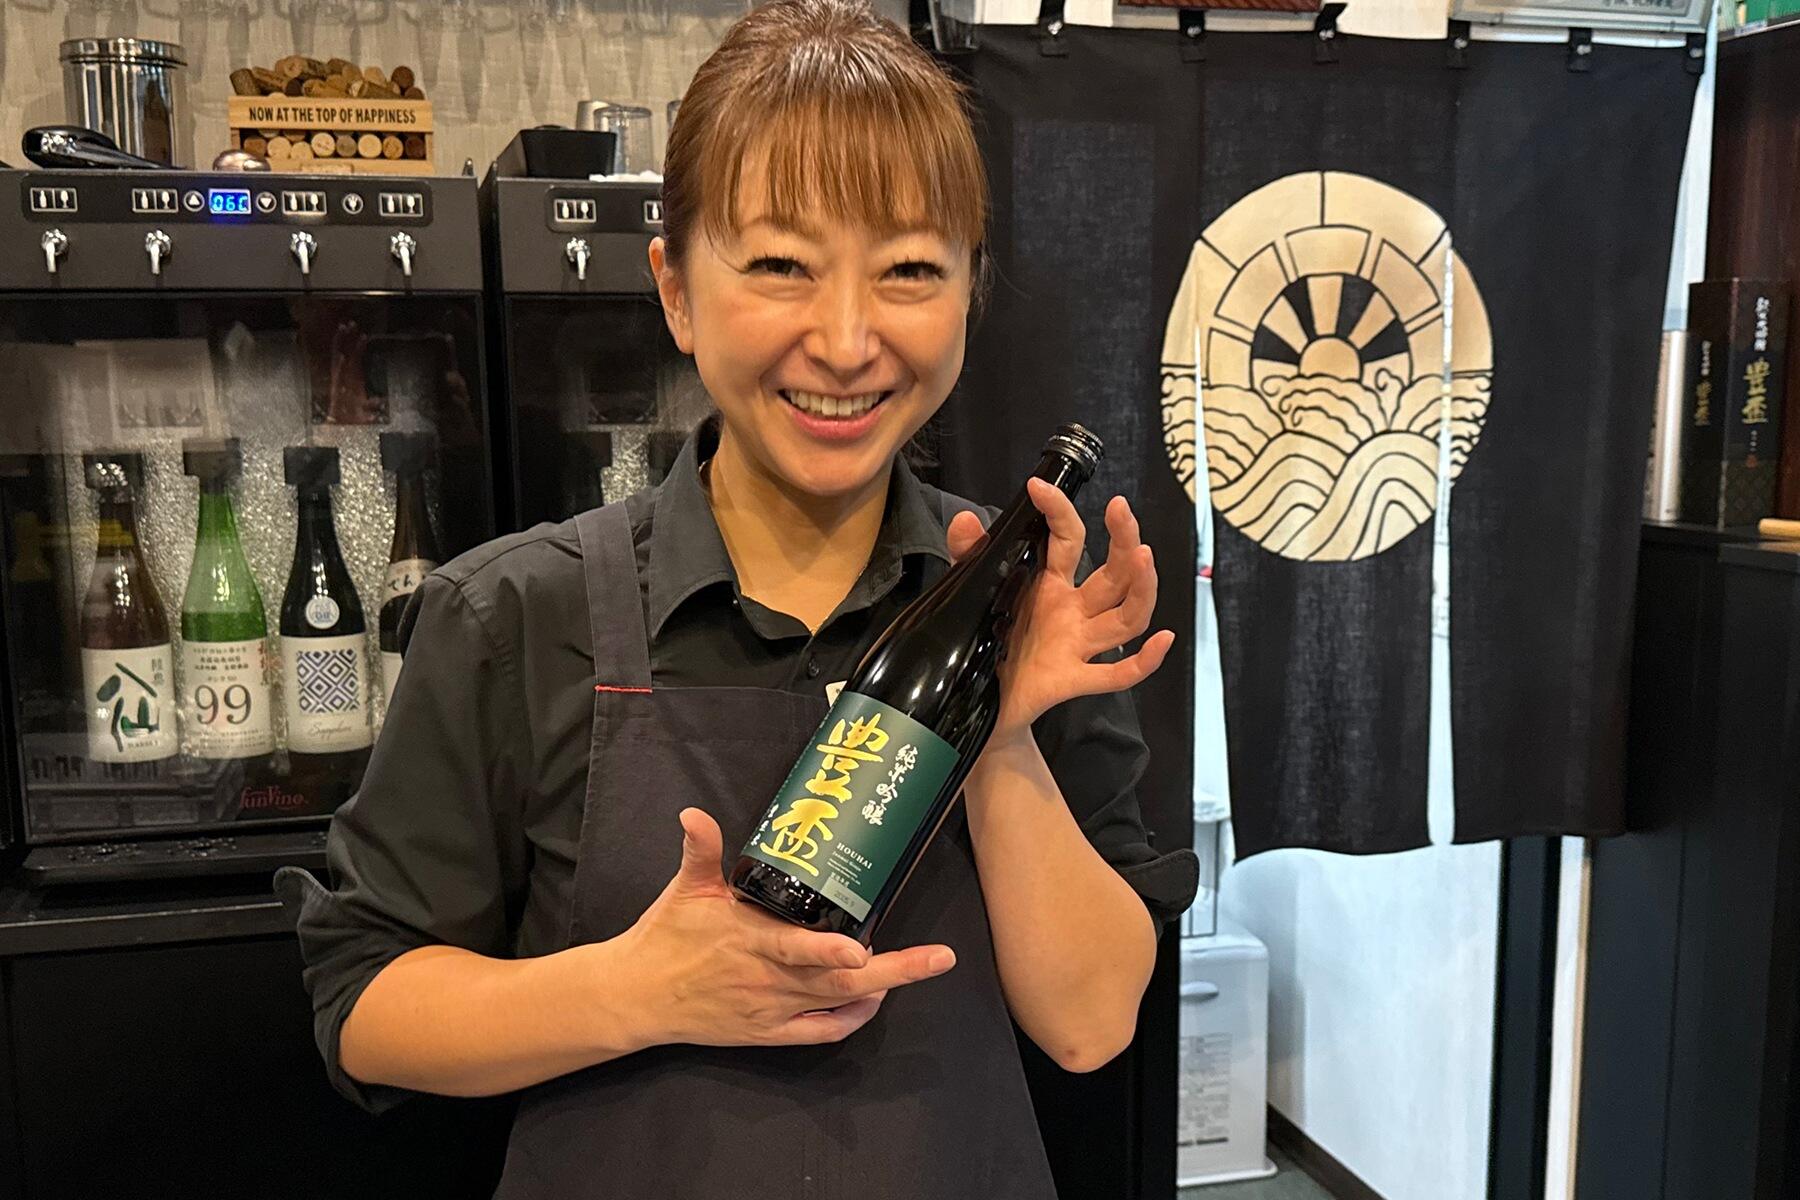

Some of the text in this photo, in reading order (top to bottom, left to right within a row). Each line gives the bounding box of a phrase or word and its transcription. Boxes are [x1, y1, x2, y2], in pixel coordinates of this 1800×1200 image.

[249, 107, 416, 124] NOW AT THE TOP OF HAPPINESS
[195, 684, 251, 724] 99
[836, 842, 873, 870] HOUHAI
